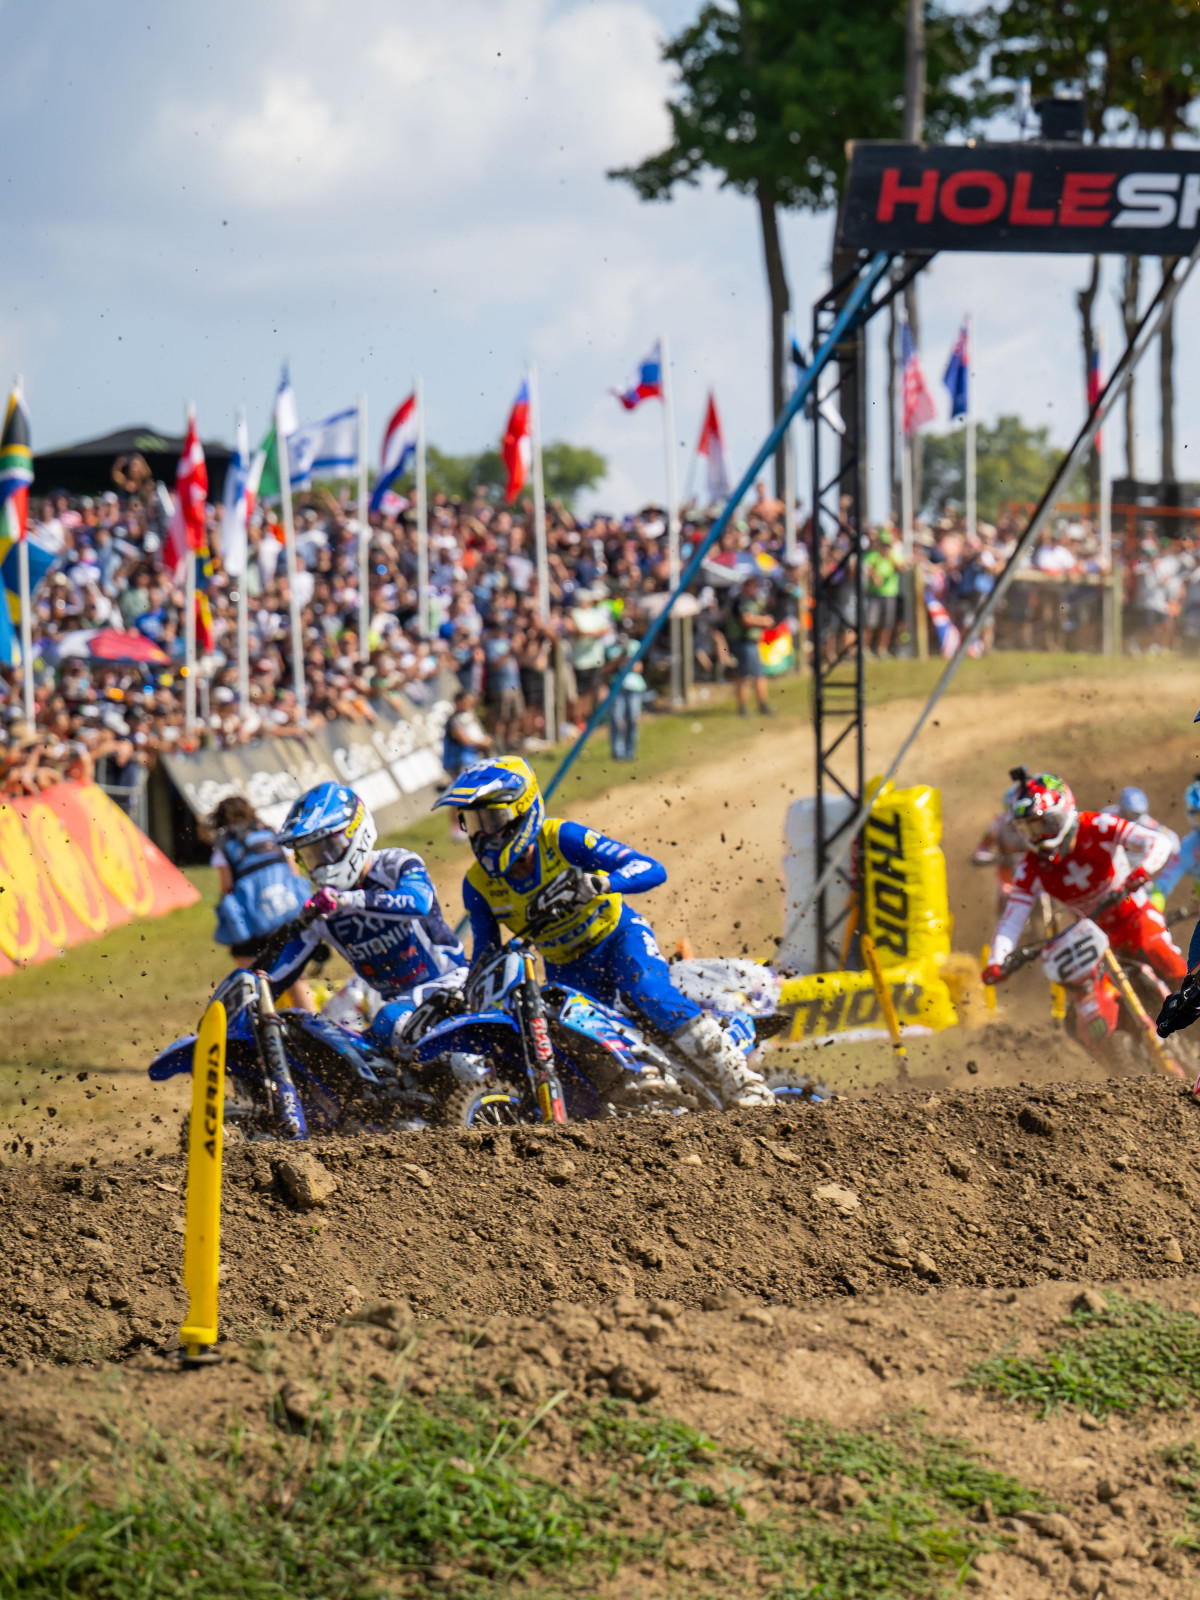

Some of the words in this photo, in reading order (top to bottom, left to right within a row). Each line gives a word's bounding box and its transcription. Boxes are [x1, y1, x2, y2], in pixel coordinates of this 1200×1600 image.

[373, 893, 417, 909] FXR
[869, 811, 909, 957] THOR
[1052, 934, 1099, 981] 25
[776, 983, 924, 1040] THOR
[204, 1042, 221, 1160] ACERBIS
